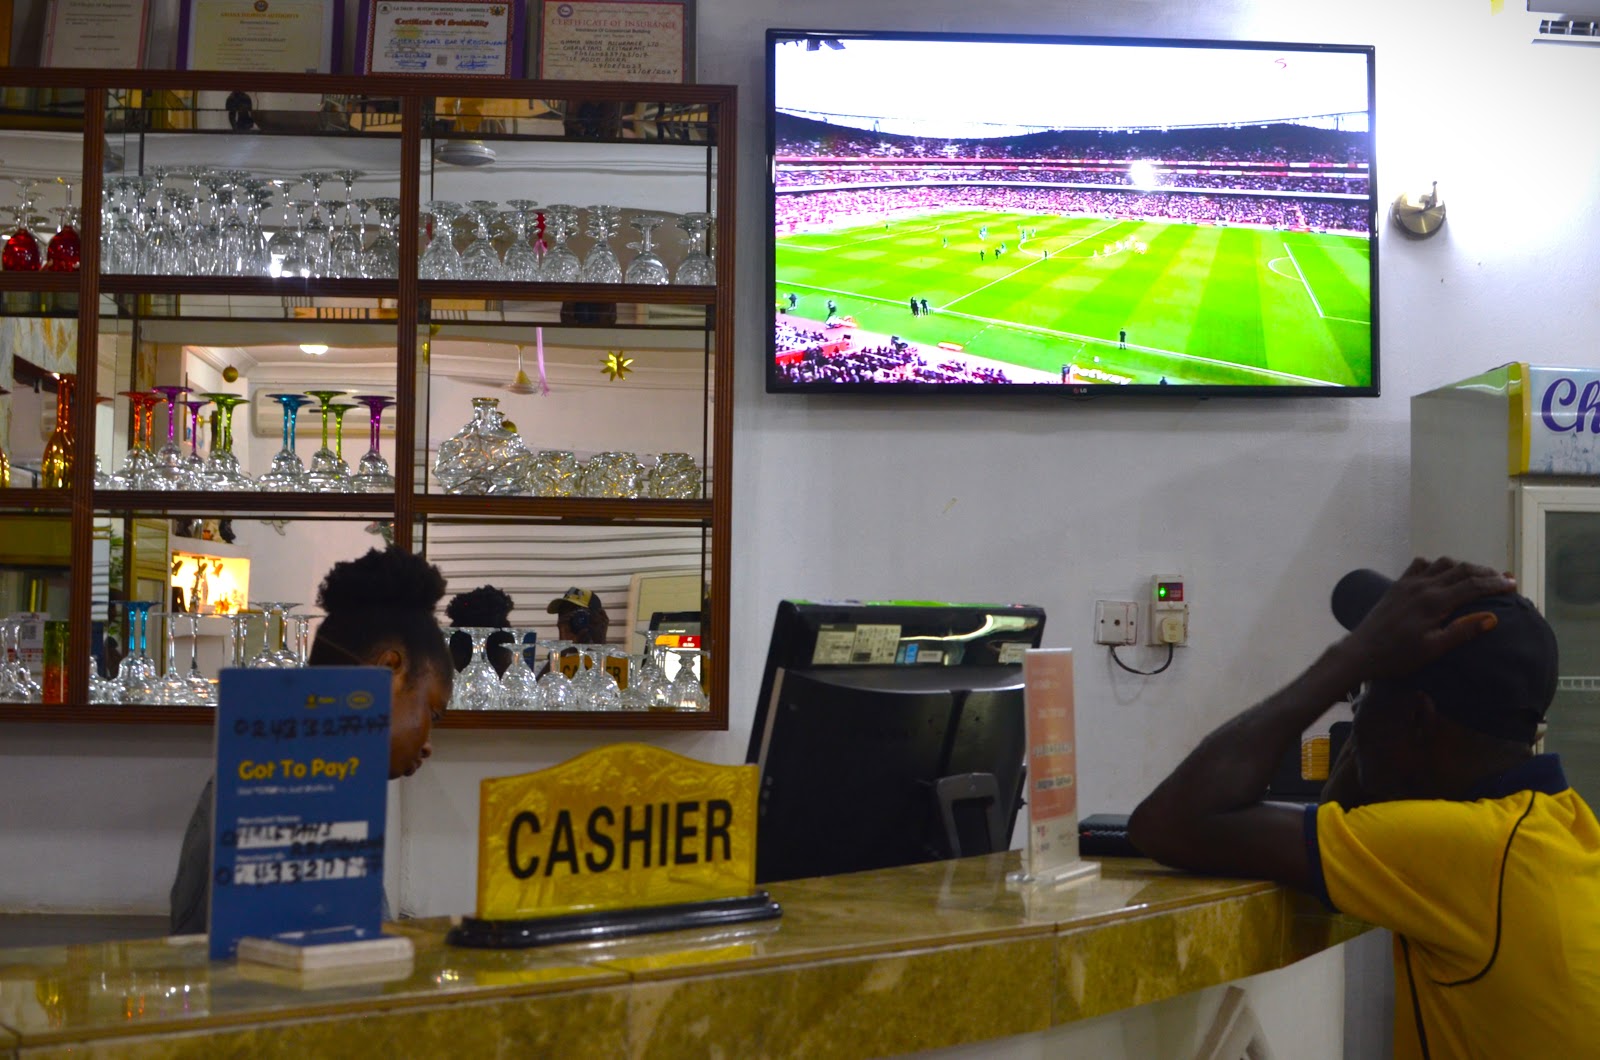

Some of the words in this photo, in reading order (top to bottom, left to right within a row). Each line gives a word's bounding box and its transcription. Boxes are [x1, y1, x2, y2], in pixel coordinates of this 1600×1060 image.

[395, 17, 432, 25] Certificate
[447, 19, 489, 28] Suitability
[552, 18, 608, 26] CERTIFICATE
[625, 20, 677, 30] INSURANCE
[238, 759, 276, 780] Got
[280, 758, 307, 778] To
[311, 756, 360, 781] Pay?
[507, 799, 733, 880] CASHIER
